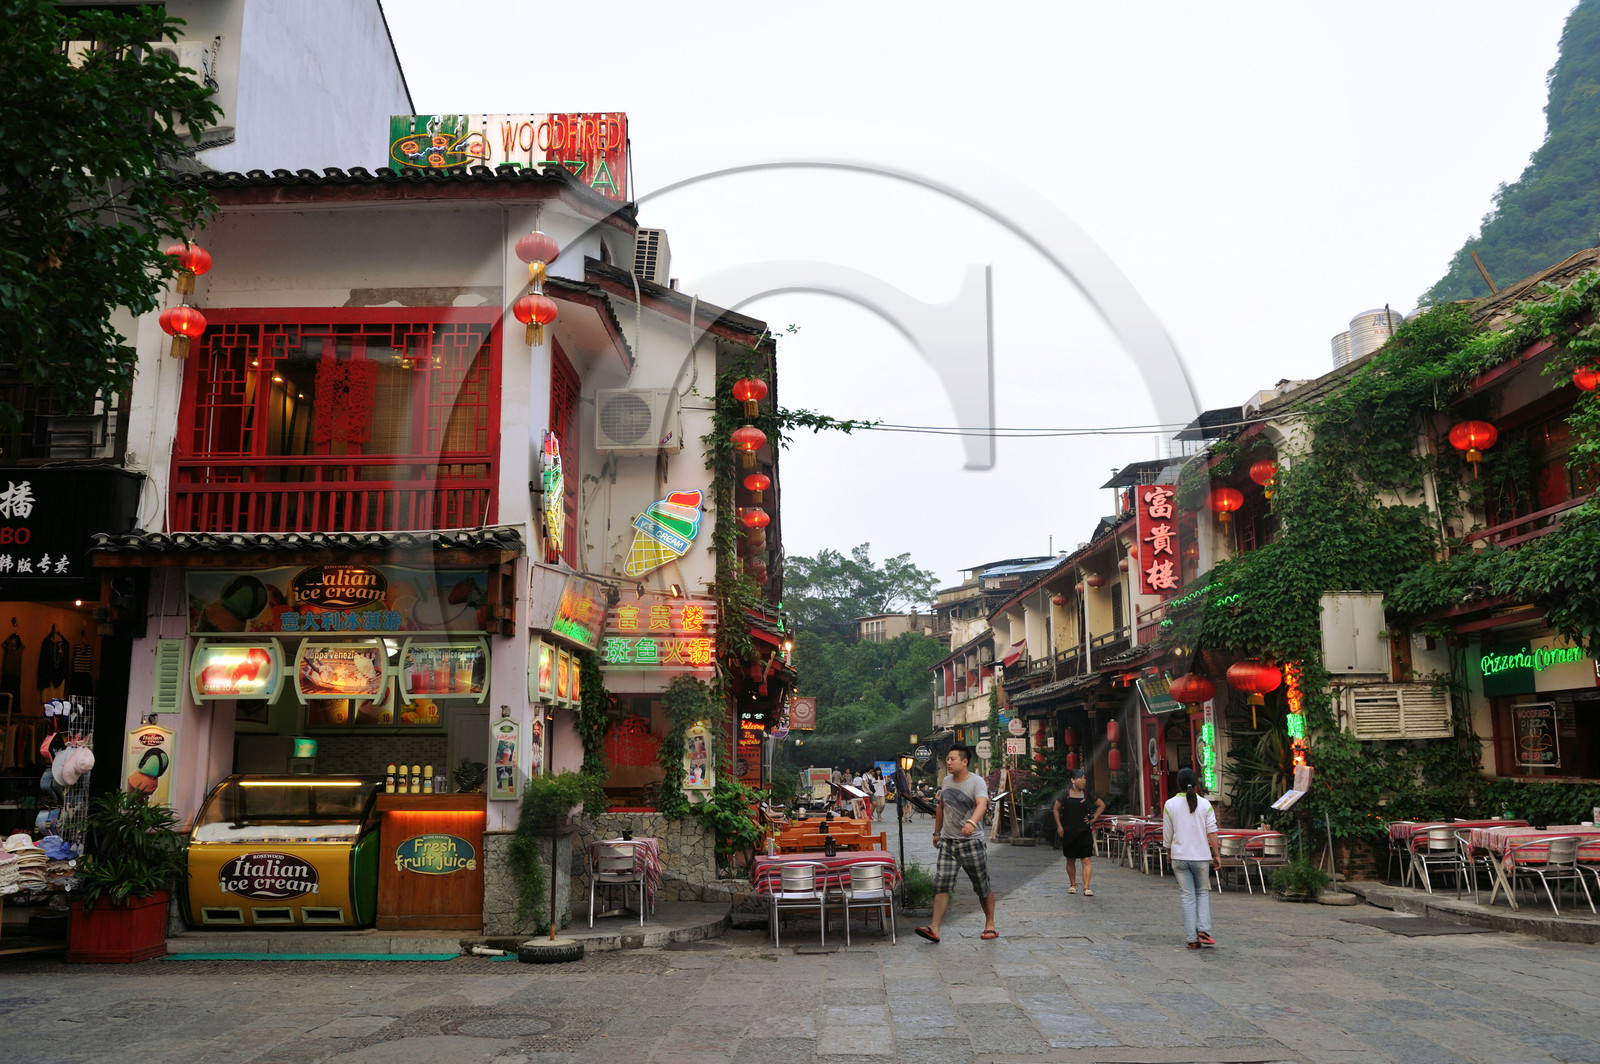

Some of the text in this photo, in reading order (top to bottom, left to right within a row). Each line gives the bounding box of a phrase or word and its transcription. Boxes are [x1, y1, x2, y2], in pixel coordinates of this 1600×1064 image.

[500, 118, 621, 152] WOODFIRED
[0, 481, 36, 519] 播
[0, 527, 31, 545] BO
[640, 520, 684, 549] ICE CREAM
[1144, 486, 1180, 591] 富貴樓
[293, 587, 387, 602] ice cream
[280, 610, 402, 631] 意大利冰淇淋
[618, 605, 704, 631] 富贵楼
[605, 637, 712, 664] 斑鱼火锅
[1481, 647, 1533, 676] Pizzeria
[1534, 645, 1580, 672] Corner
[1516, 709, 1550, 718] WOODFIRED
[1520, 718, 1549, 731] PIZZA
[1007, 746, 1017, 754] 60
[414, 838, 457, 853] Fresh
[232, 855, 309, 877] Italian
[394, 852, 477, 871] fruit juice
[219, 877, 319, 894] ice cream
